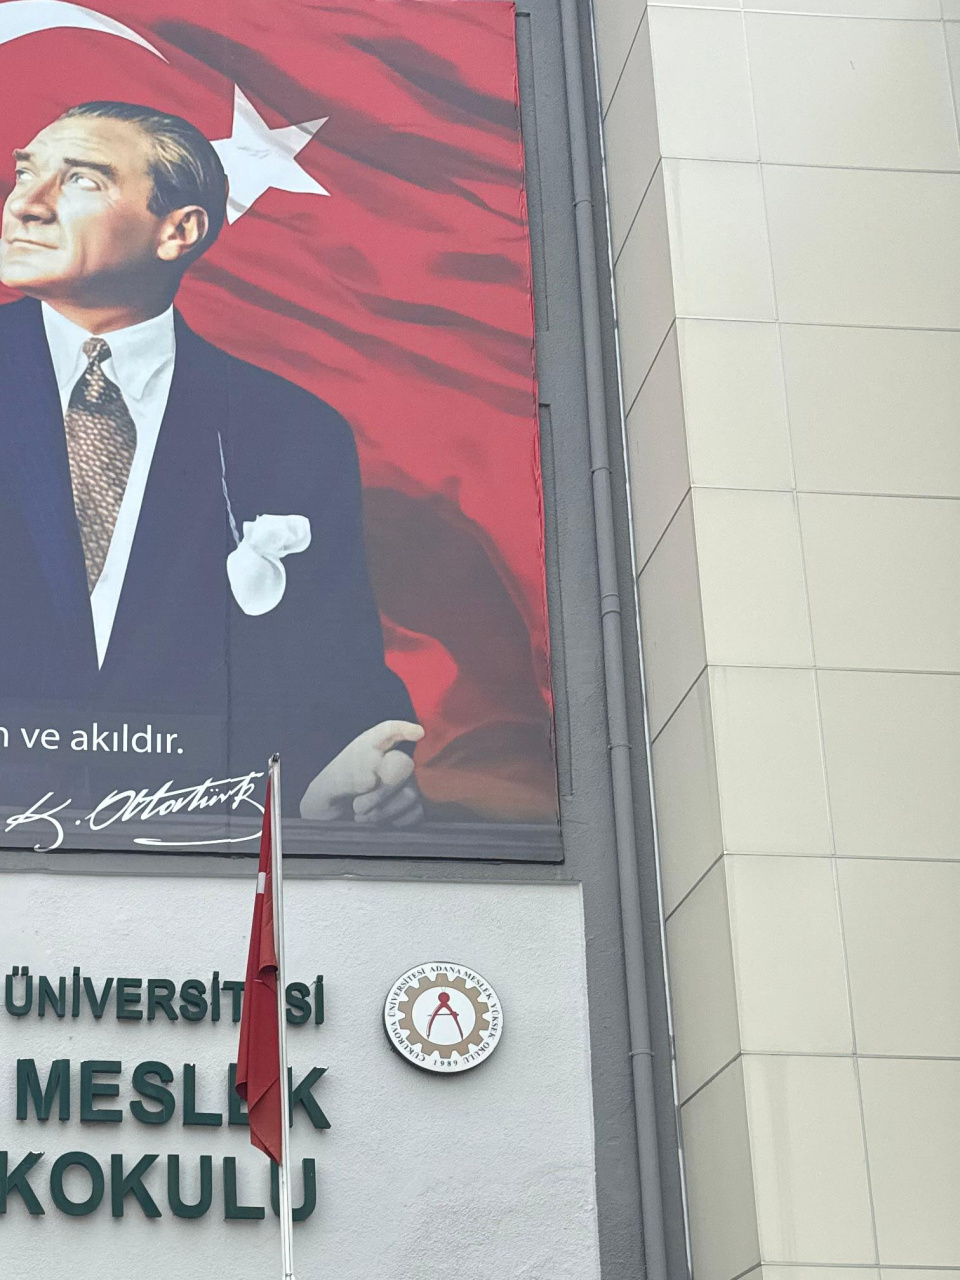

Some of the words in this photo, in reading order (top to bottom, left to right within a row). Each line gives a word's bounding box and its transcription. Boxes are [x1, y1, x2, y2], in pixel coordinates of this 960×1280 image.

[19, 726, 61, 751] ve
[70, 723, 185, 755] akıldır.
[5, 966, 326, 1029] ÜNİVERSİTSİ
[429, 965, 461, 976] ADANA
[464, 971, 493, 1001] MESLEK
